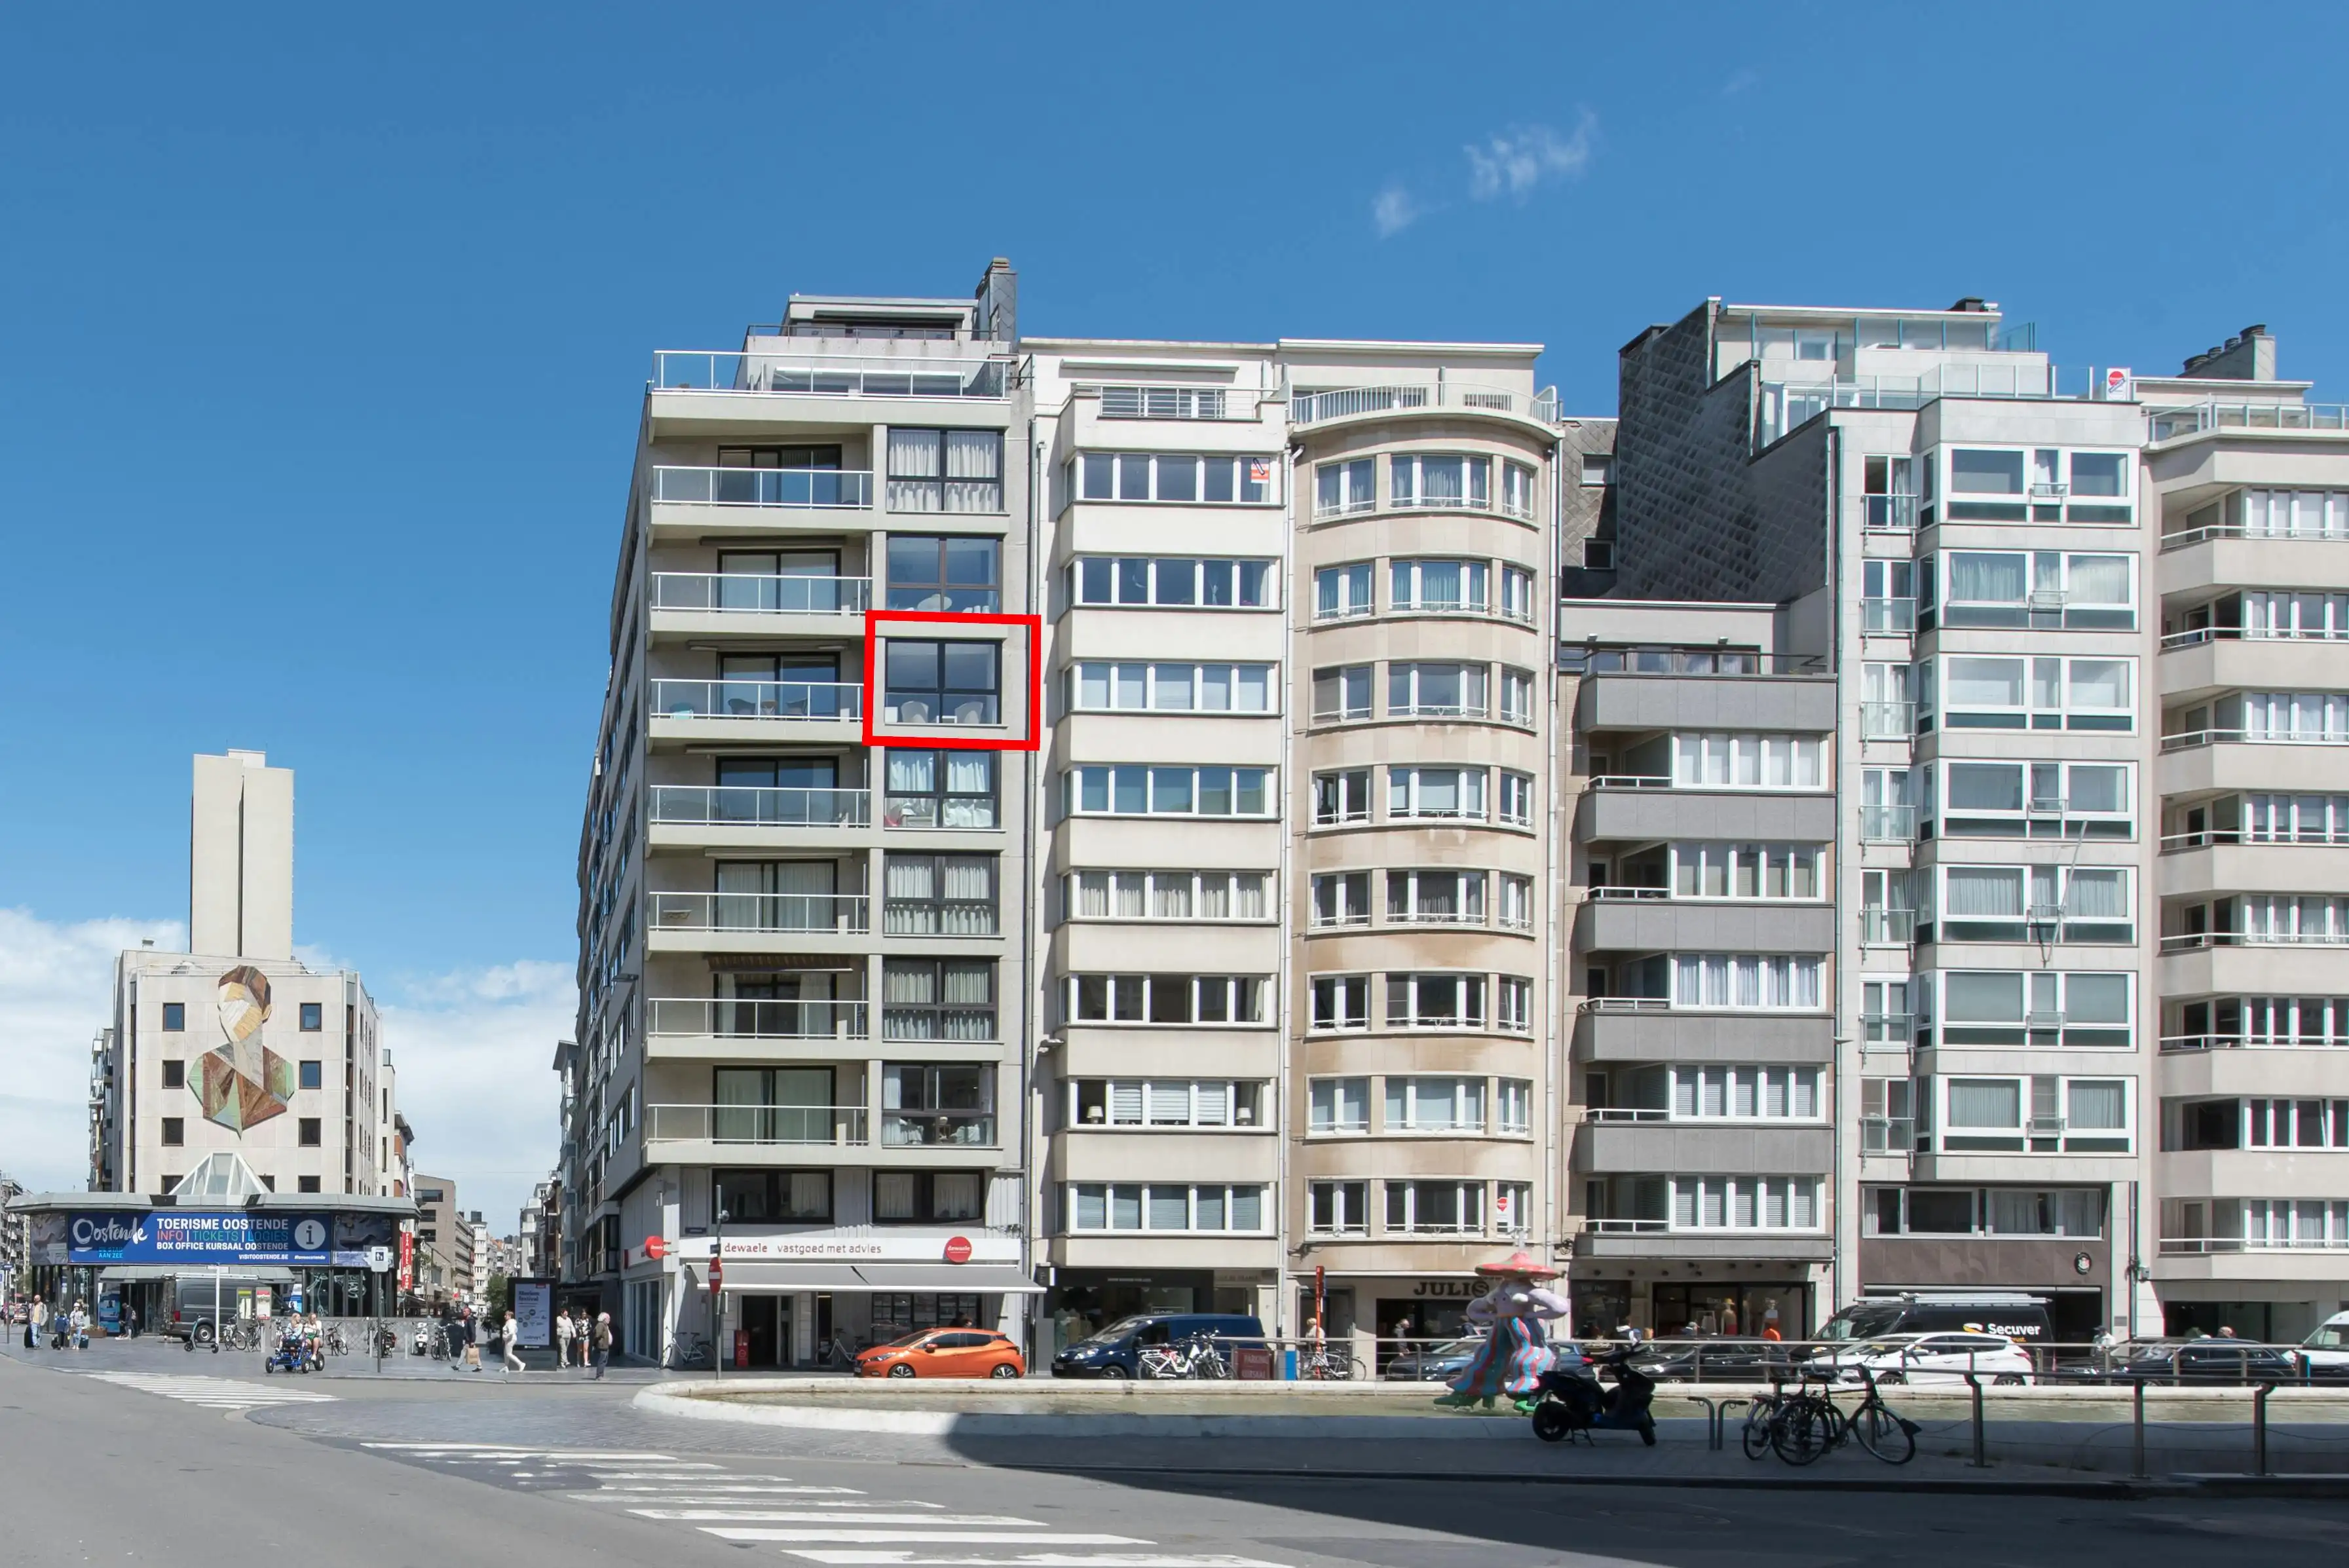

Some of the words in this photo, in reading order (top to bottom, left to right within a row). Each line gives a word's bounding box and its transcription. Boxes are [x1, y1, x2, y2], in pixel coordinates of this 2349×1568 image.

[157, 1218, 219, 1230] TOERISME
[222, 1218, 289, 1230] OOSTENDE
[73, 1218, 149, 1244] Oostende
[157, 1231, 183, 1241] INFO
[193, 1231, 238, 1241] TICKETS
[248, 1231, 288, 1241] LOGIES
[724, 1242, 768, 1252] dewaele
[777, 1244, 824, 1255] vastgoed
[827, 1244, 846, 1253] met
[849, 1244, 882, 1253] advies
[1988, 1323, 2041, 1335] Secuver
